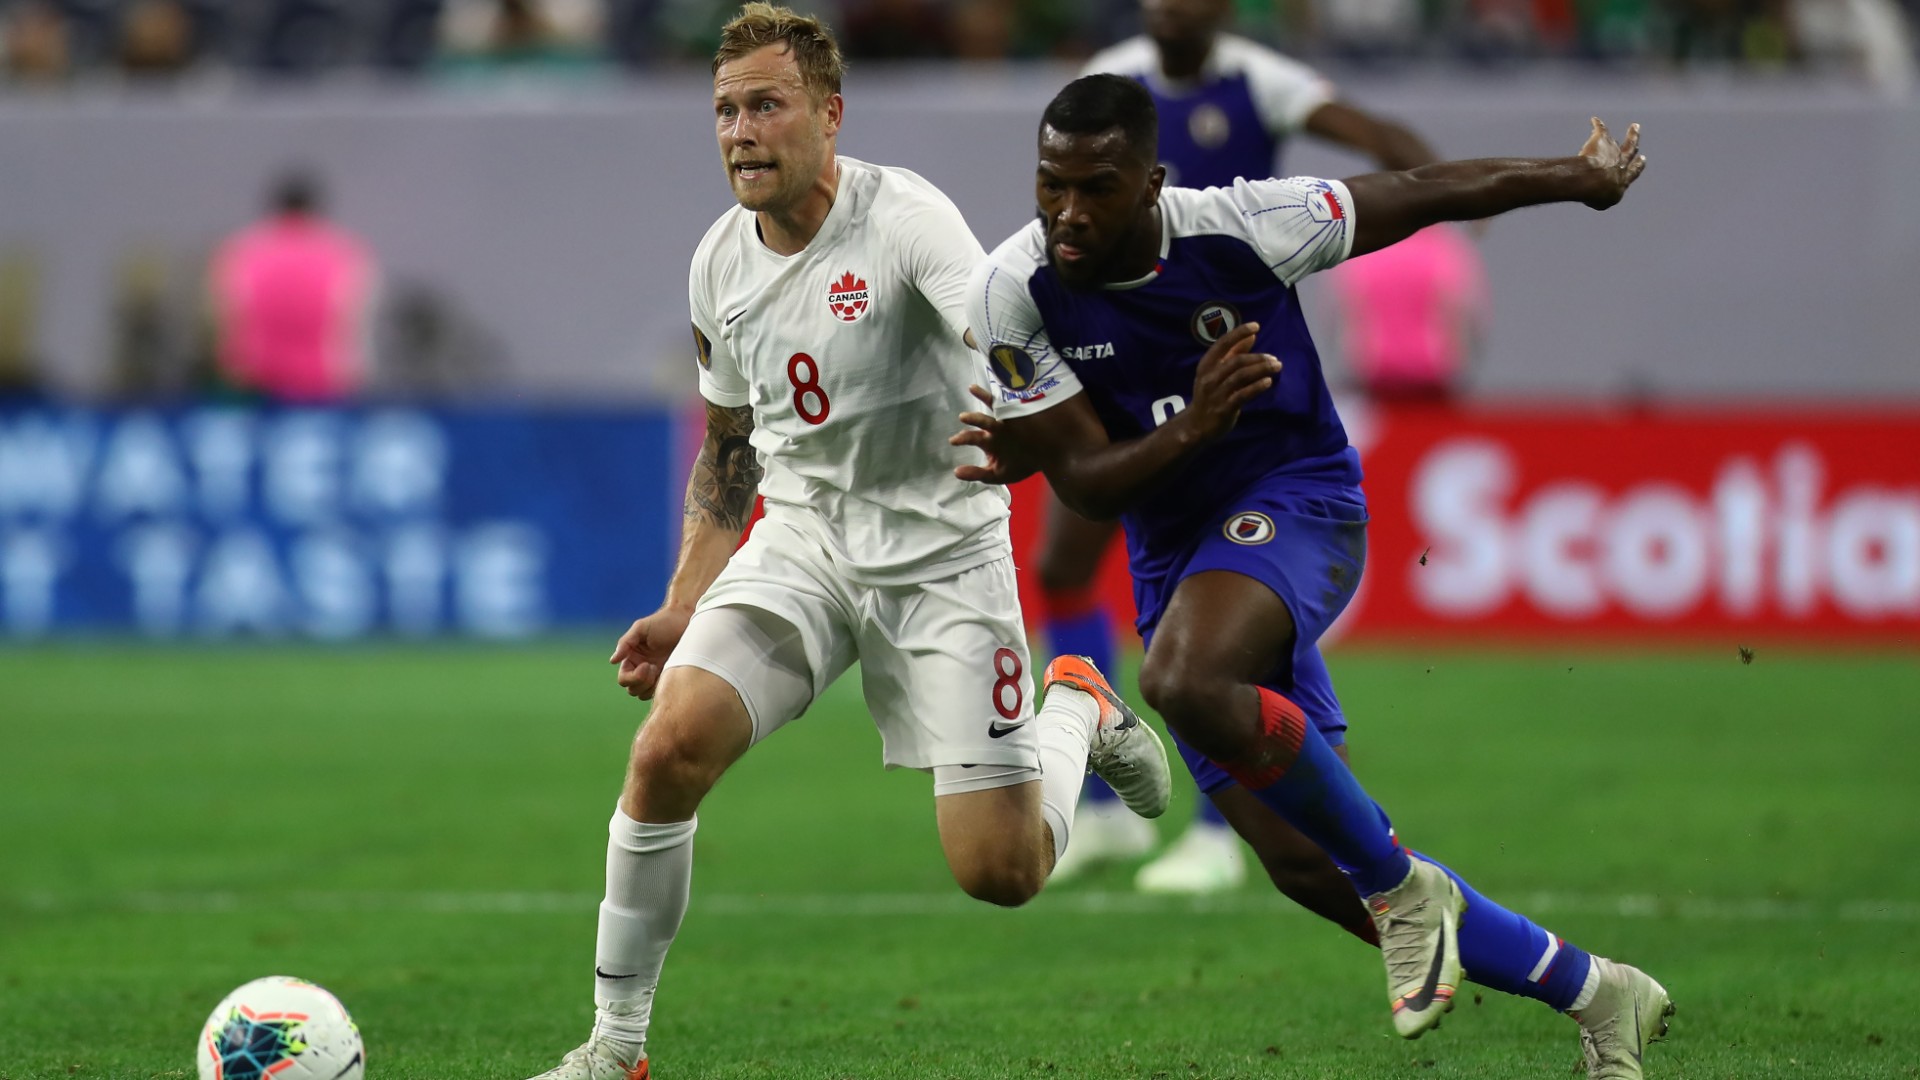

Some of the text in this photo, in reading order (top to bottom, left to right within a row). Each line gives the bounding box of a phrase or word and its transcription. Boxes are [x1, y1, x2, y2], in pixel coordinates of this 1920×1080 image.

[828, 291, 869, 303] CANADA
[1061, 341, 1115, 361] SAETA
[787, 352, 830, 425] 8
[992, 647, 1023, 720] 8
